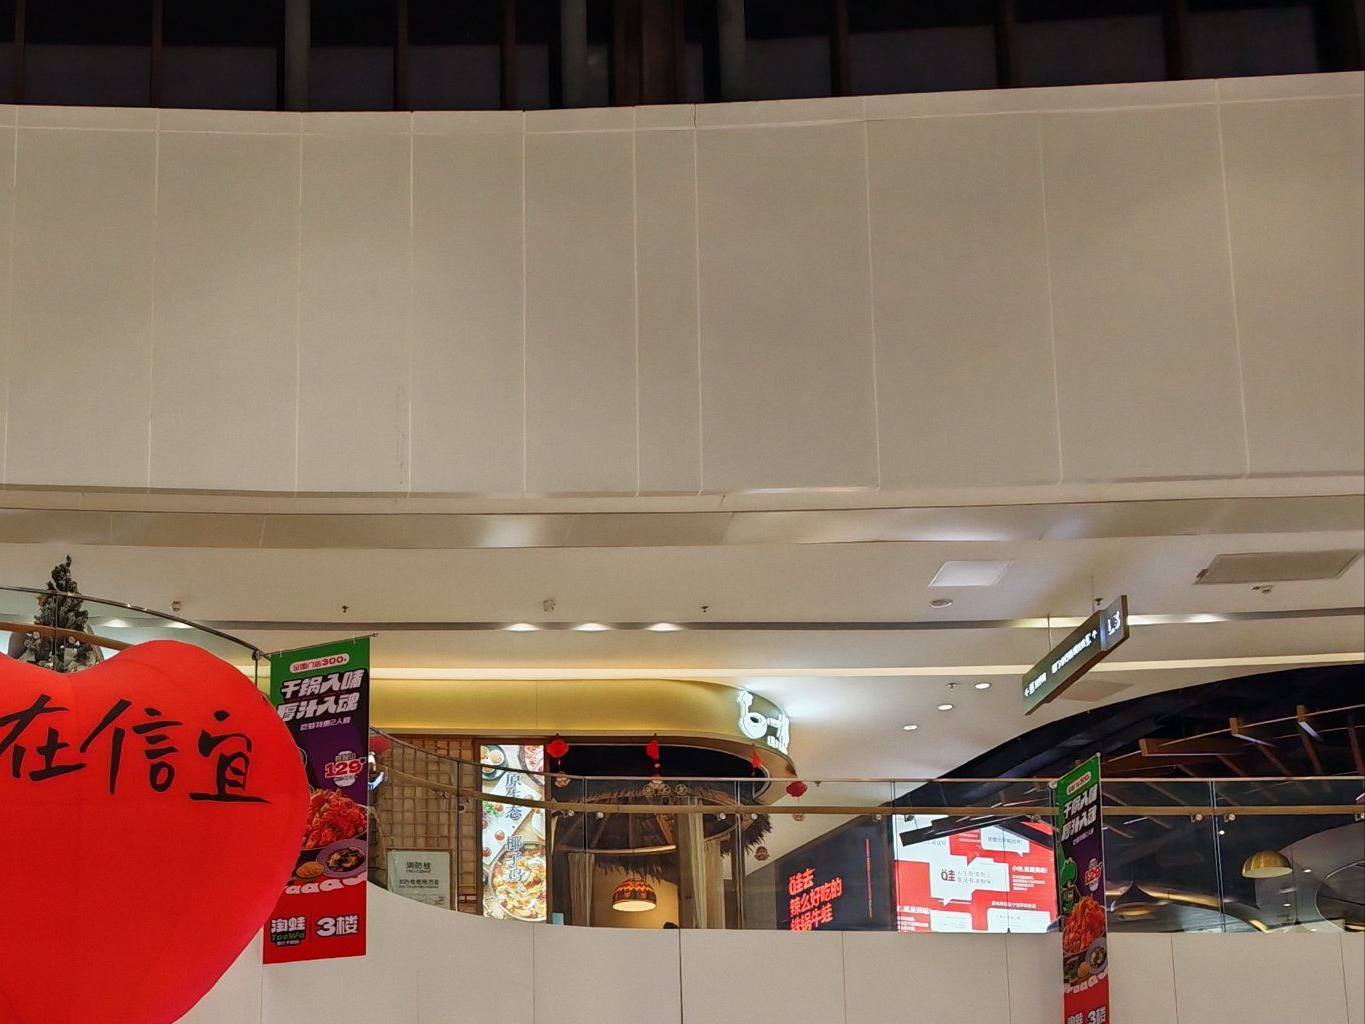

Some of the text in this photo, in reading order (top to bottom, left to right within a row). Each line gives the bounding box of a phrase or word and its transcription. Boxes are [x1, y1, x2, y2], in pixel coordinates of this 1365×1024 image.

[280, 669, 365, 699] 干锅入味
[325, 760, 365, 778] 129
[790, 877, 842, 917] 辣么好吃的
[271, 915, 359, 937] 淘蛙 3楼
